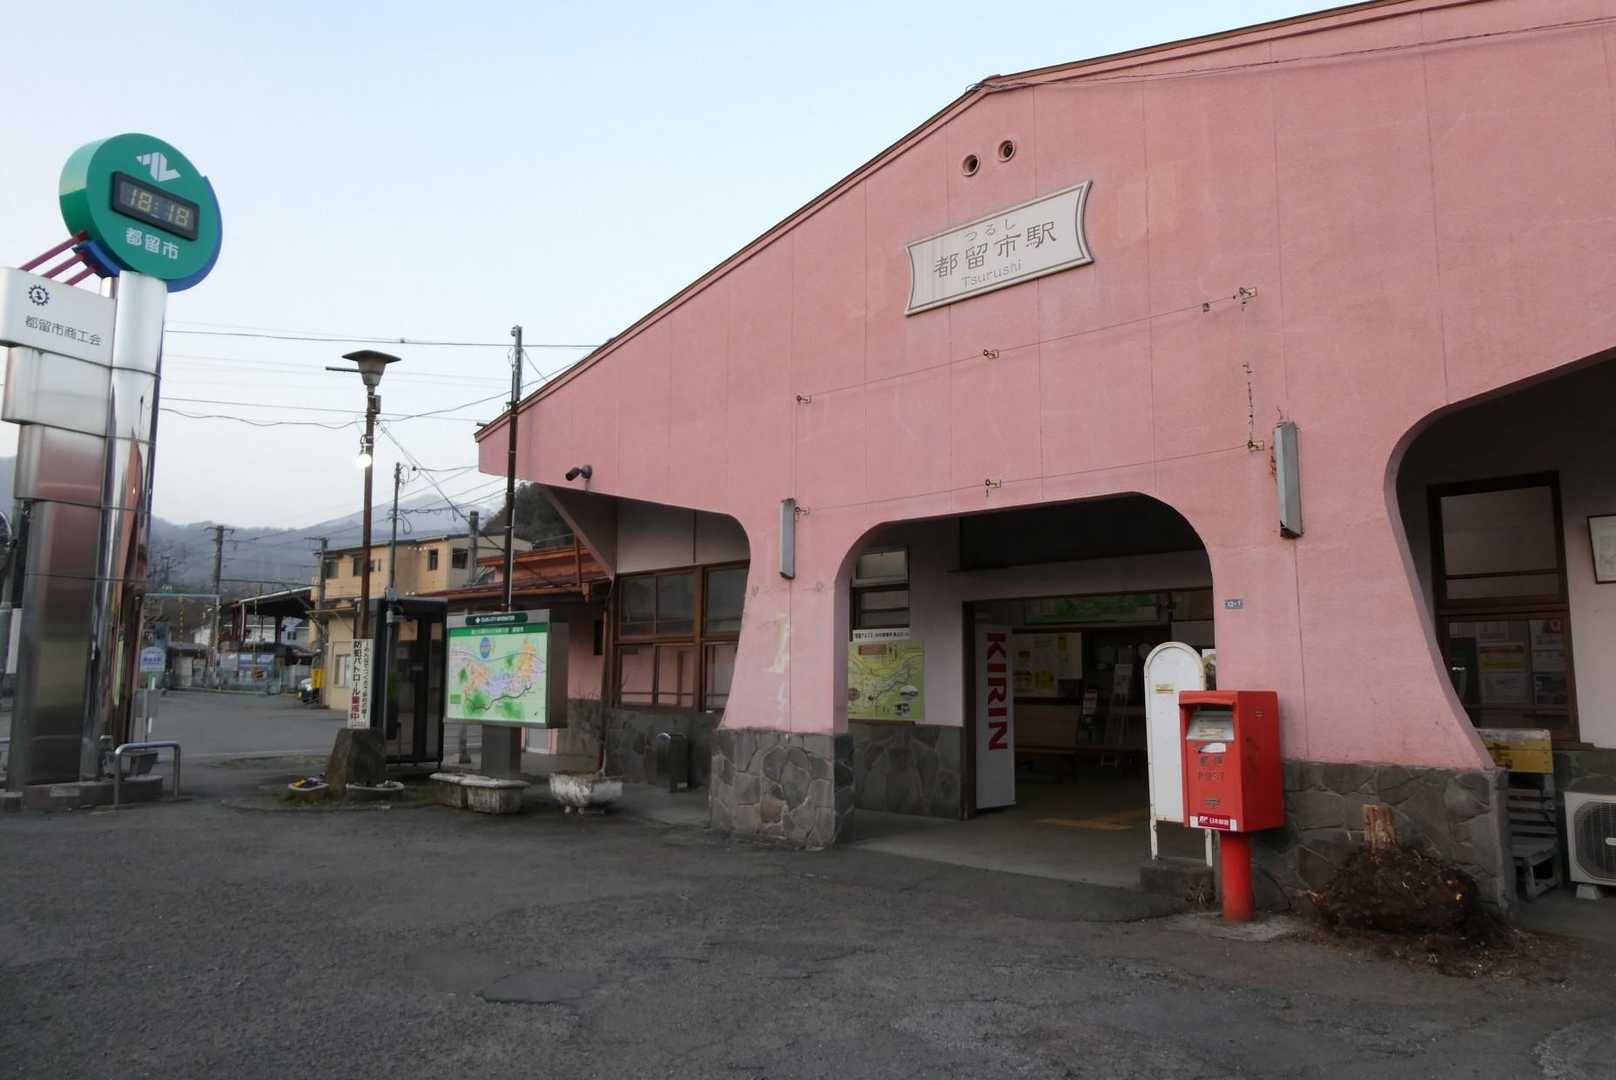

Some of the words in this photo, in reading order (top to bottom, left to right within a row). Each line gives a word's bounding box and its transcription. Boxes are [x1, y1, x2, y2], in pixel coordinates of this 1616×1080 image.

[129, 188, 190, 227] 18:18
[126, 227, 180, 260] 都留市
[965, 218, 1017, 242] つるし
[933, 221, 1057, 279] 都留市駅
[961, 259, 1023, 288] Tsurushi
[25, 314, 101, 346] 都留市商工会
[986, 632, 1009, 751] KIRIN
